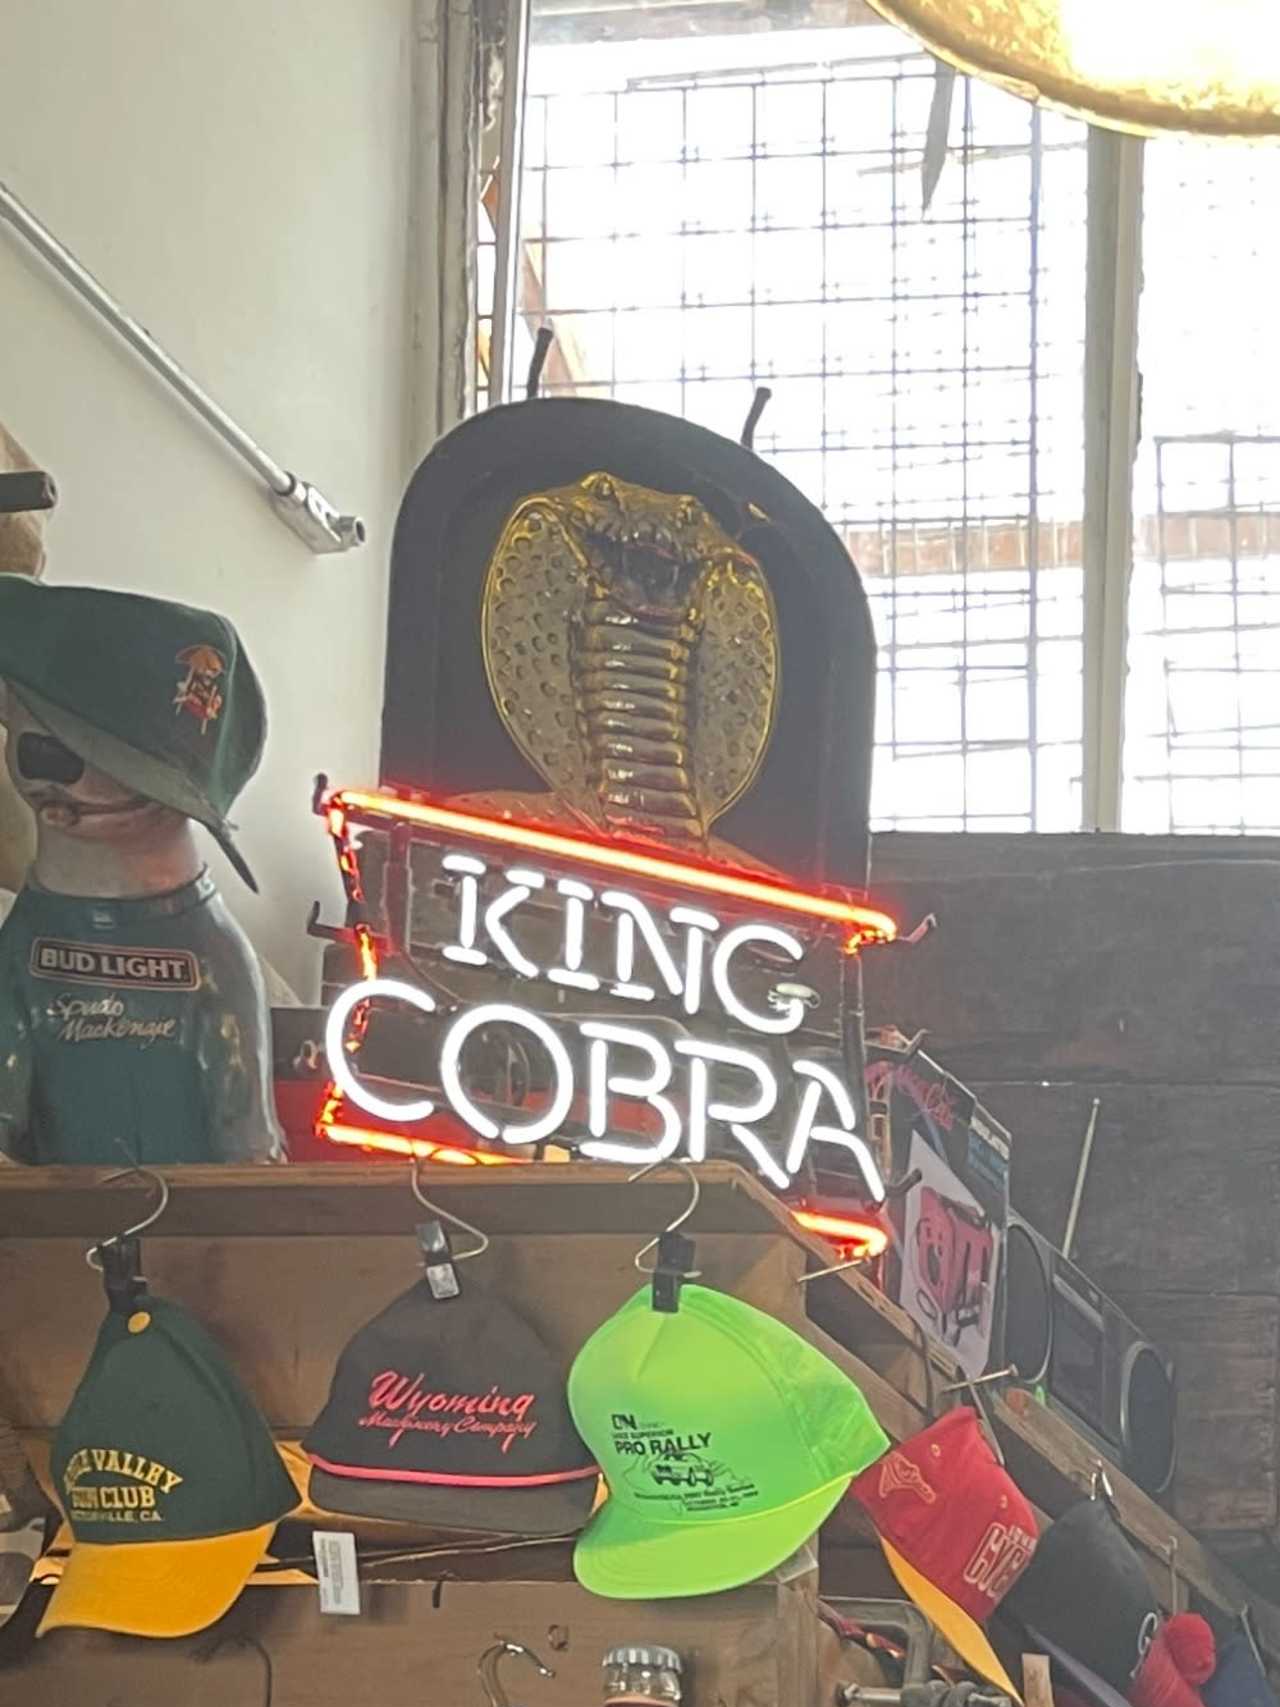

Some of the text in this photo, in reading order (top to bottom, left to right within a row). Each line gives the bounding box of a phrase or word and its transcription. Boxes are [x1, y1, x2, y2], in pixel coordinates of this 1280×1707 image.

[41, 948, 185, 979] BUD LIGHT
[442, 855, 811, 1034] KING
[325, 978, 885, 1201] COBRA
[369, 1370, 535, 1422] Wyoming
[615, 1432, 711, 1456] PRO RALLY
[91, 1449, 183, 1494] VALLEY
[100, 1486, 156, 1508] CLUB
